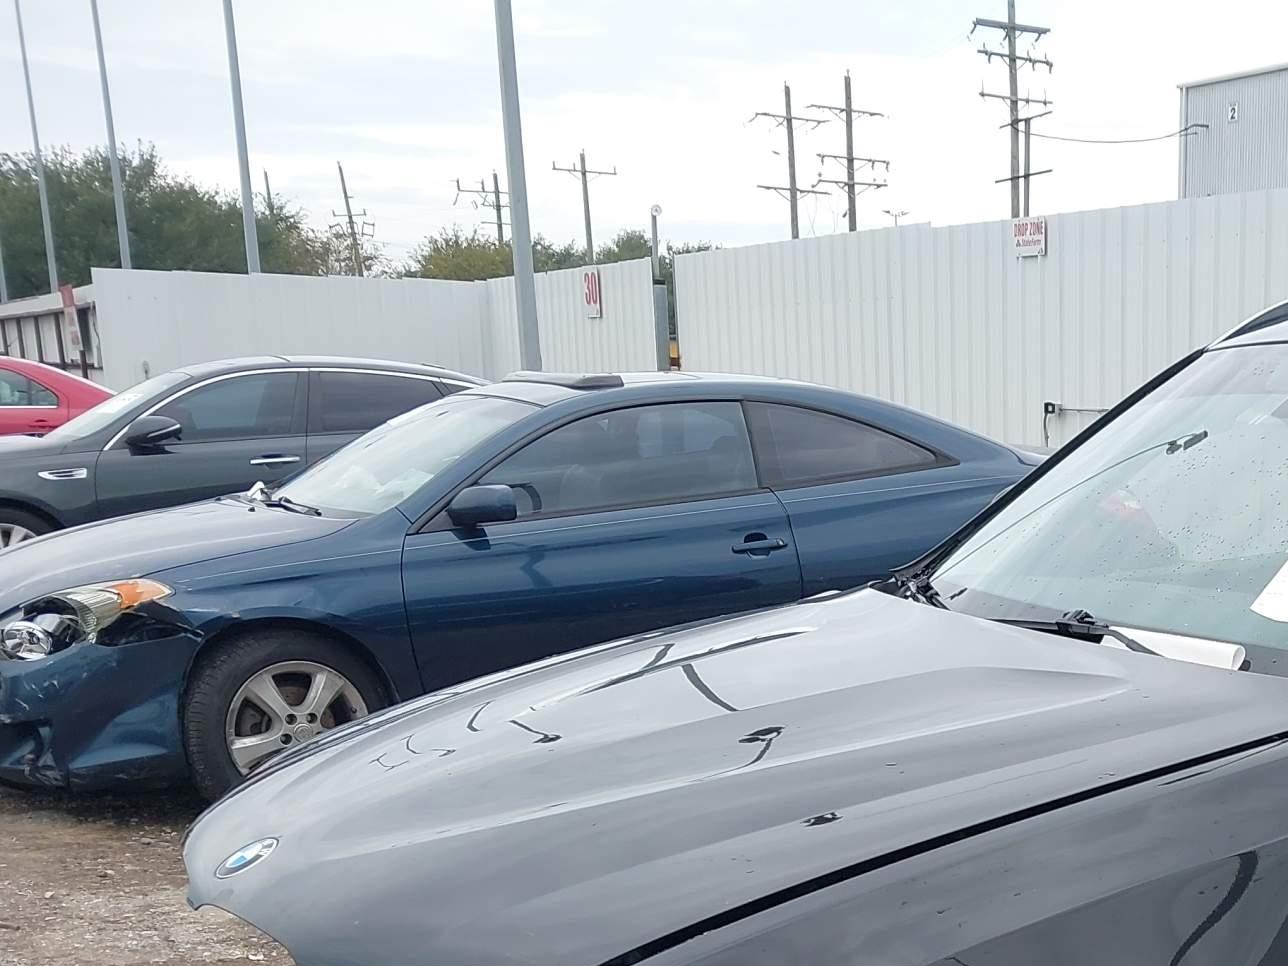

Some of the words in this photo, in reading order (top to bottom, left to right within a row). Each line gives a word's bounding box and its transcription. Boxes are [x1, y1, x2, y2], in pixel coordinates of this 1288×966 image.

[1230, 107, 1236, 120] 2
[1014, 222, 1028, 238] DROP
[1029, 220, 1043, 236] ZONE
[584, 271, 598, 305] 30
